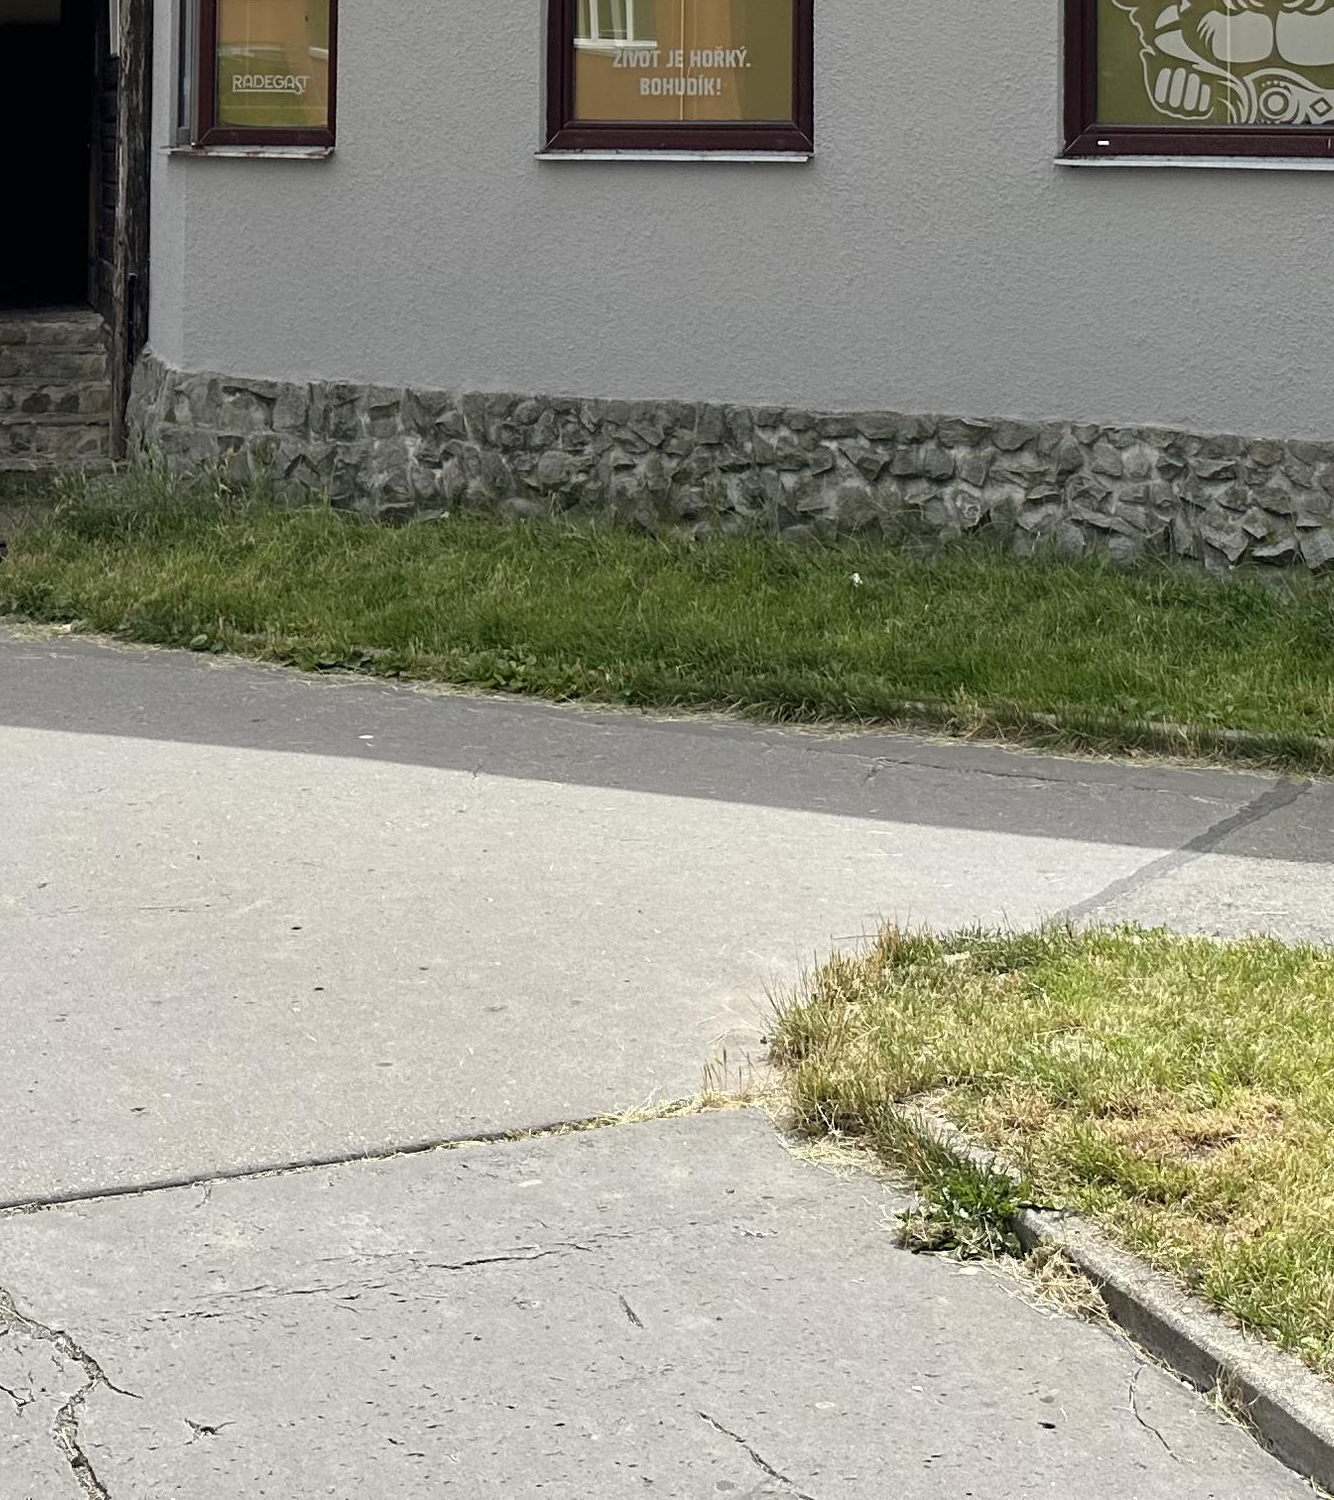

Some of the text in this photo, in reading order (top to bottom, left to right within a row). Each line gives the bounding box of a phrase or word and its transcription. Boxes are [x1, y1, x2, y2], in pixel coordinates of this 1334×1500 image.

[666, 49, 684, 68] JE
[690, 46, 752, 68] HOŘKÝ.
[232, 74, 310, 95] RADEGAST
[639, 74, 722, 96] BOHUDÍK!
